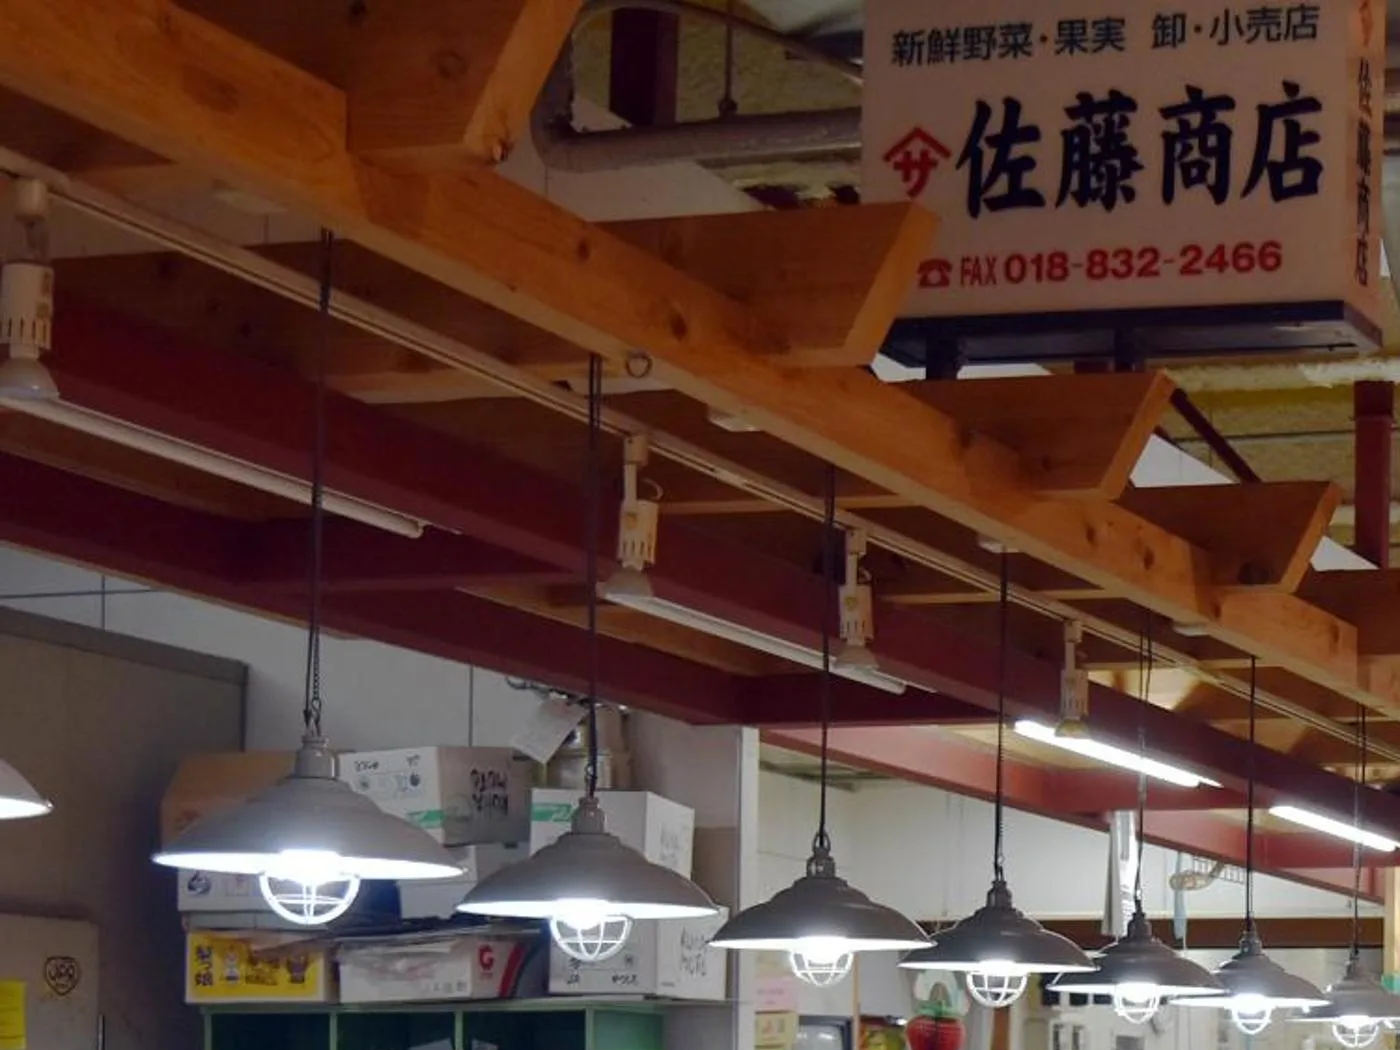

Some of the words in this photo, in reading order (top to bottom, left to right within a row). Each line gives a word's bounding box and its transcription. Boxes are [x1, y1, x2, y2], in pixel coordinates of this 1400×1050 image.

[891, 16, 1126, 67] 新鮮野菜・果実
[1151, 5, 1321, 50] 卸・小売店
[956, 80, 1325, 220] 佐藤商店
[960, 255, 998, 288] FAX
[1004, 240, 1283, 286] 018-832-2466
